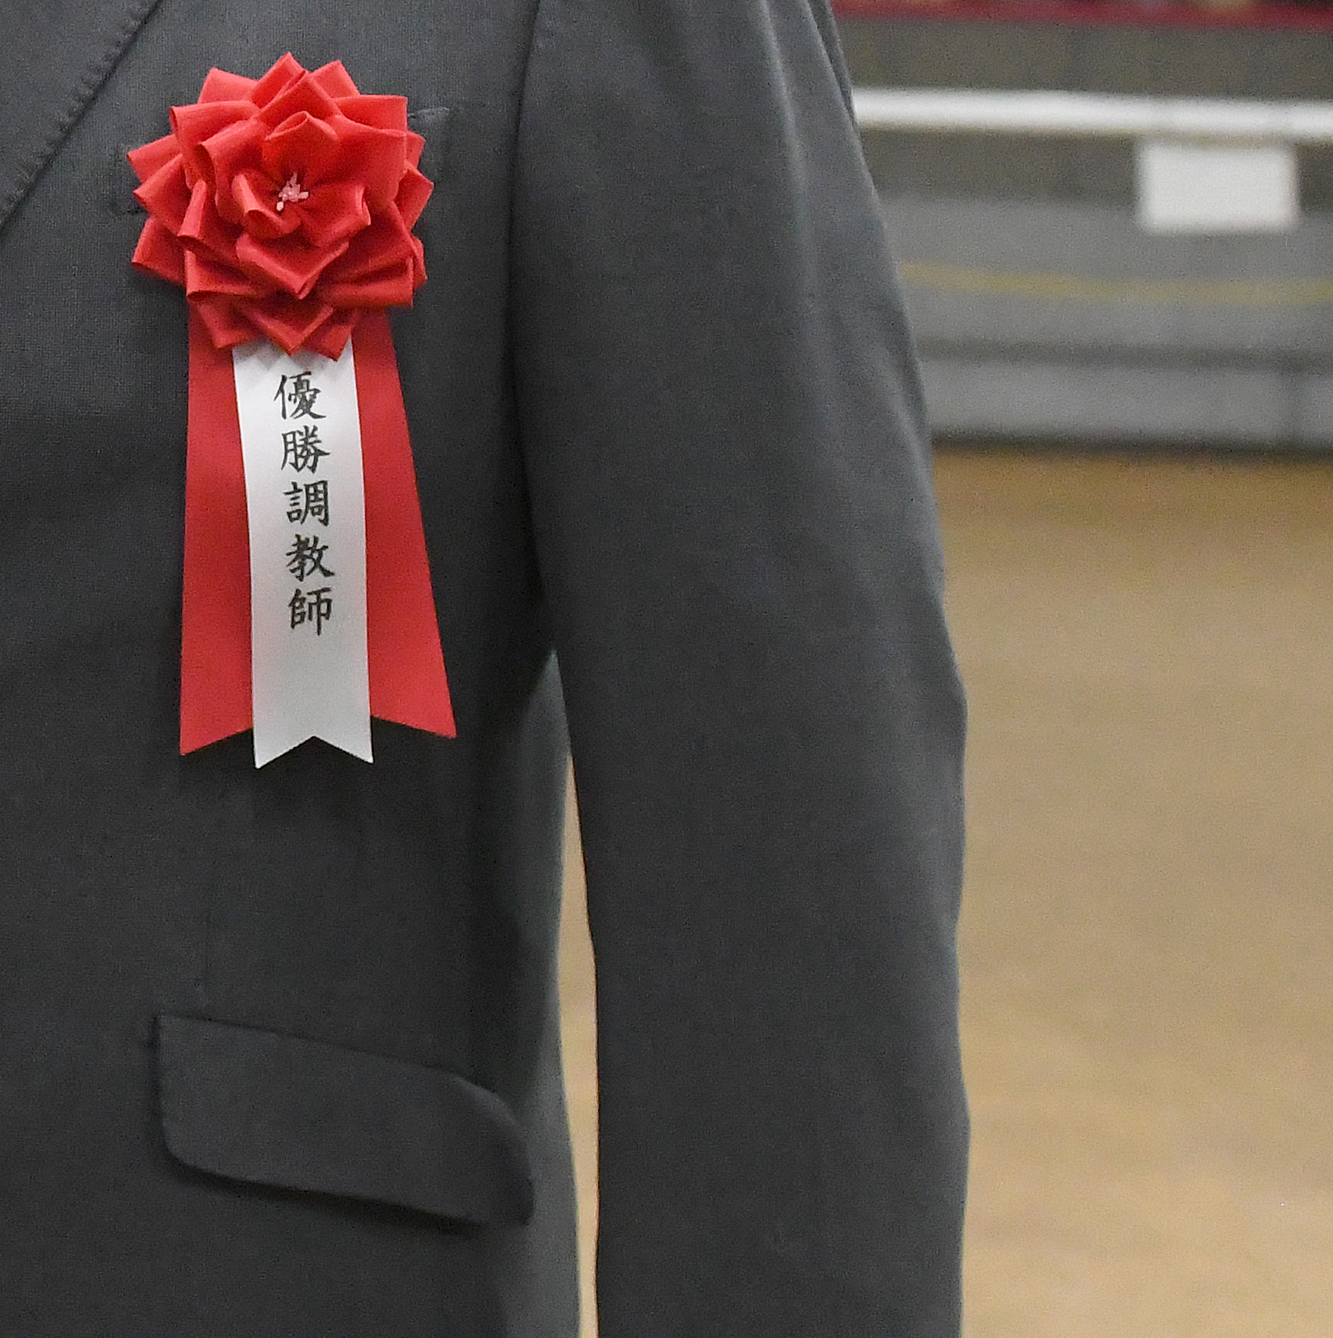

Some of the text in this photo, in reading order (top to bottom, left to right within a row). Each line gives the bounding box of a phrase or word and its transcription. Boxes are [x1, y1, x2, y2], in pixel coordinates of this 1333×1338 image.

[274, 371, 336, 636] 優勝調教師
